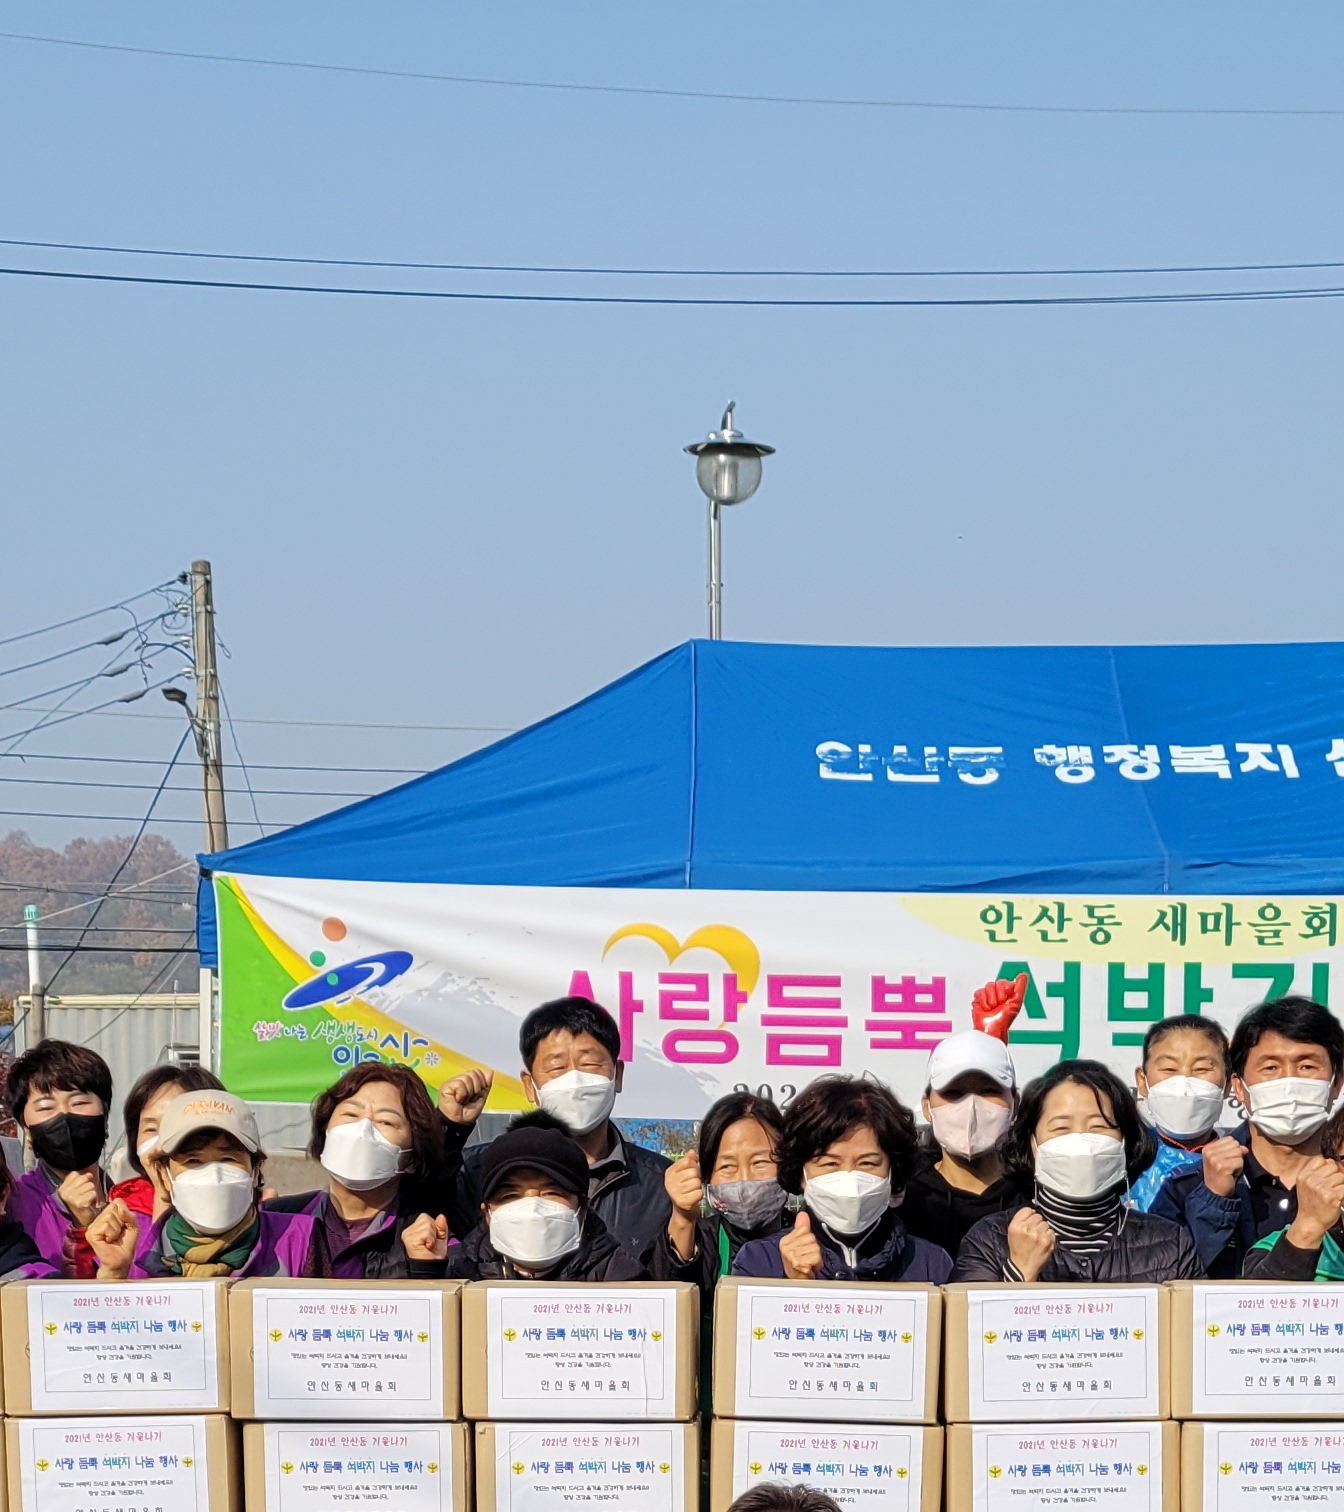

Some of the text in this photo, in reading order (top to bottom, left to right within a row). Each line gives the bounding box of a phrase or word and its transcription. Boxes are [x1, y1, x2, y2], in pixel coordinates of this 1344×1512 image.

[1034, 742, 1299, 783] 행정복지
[979, 901, 1338, 947] 안산동 새마을회
